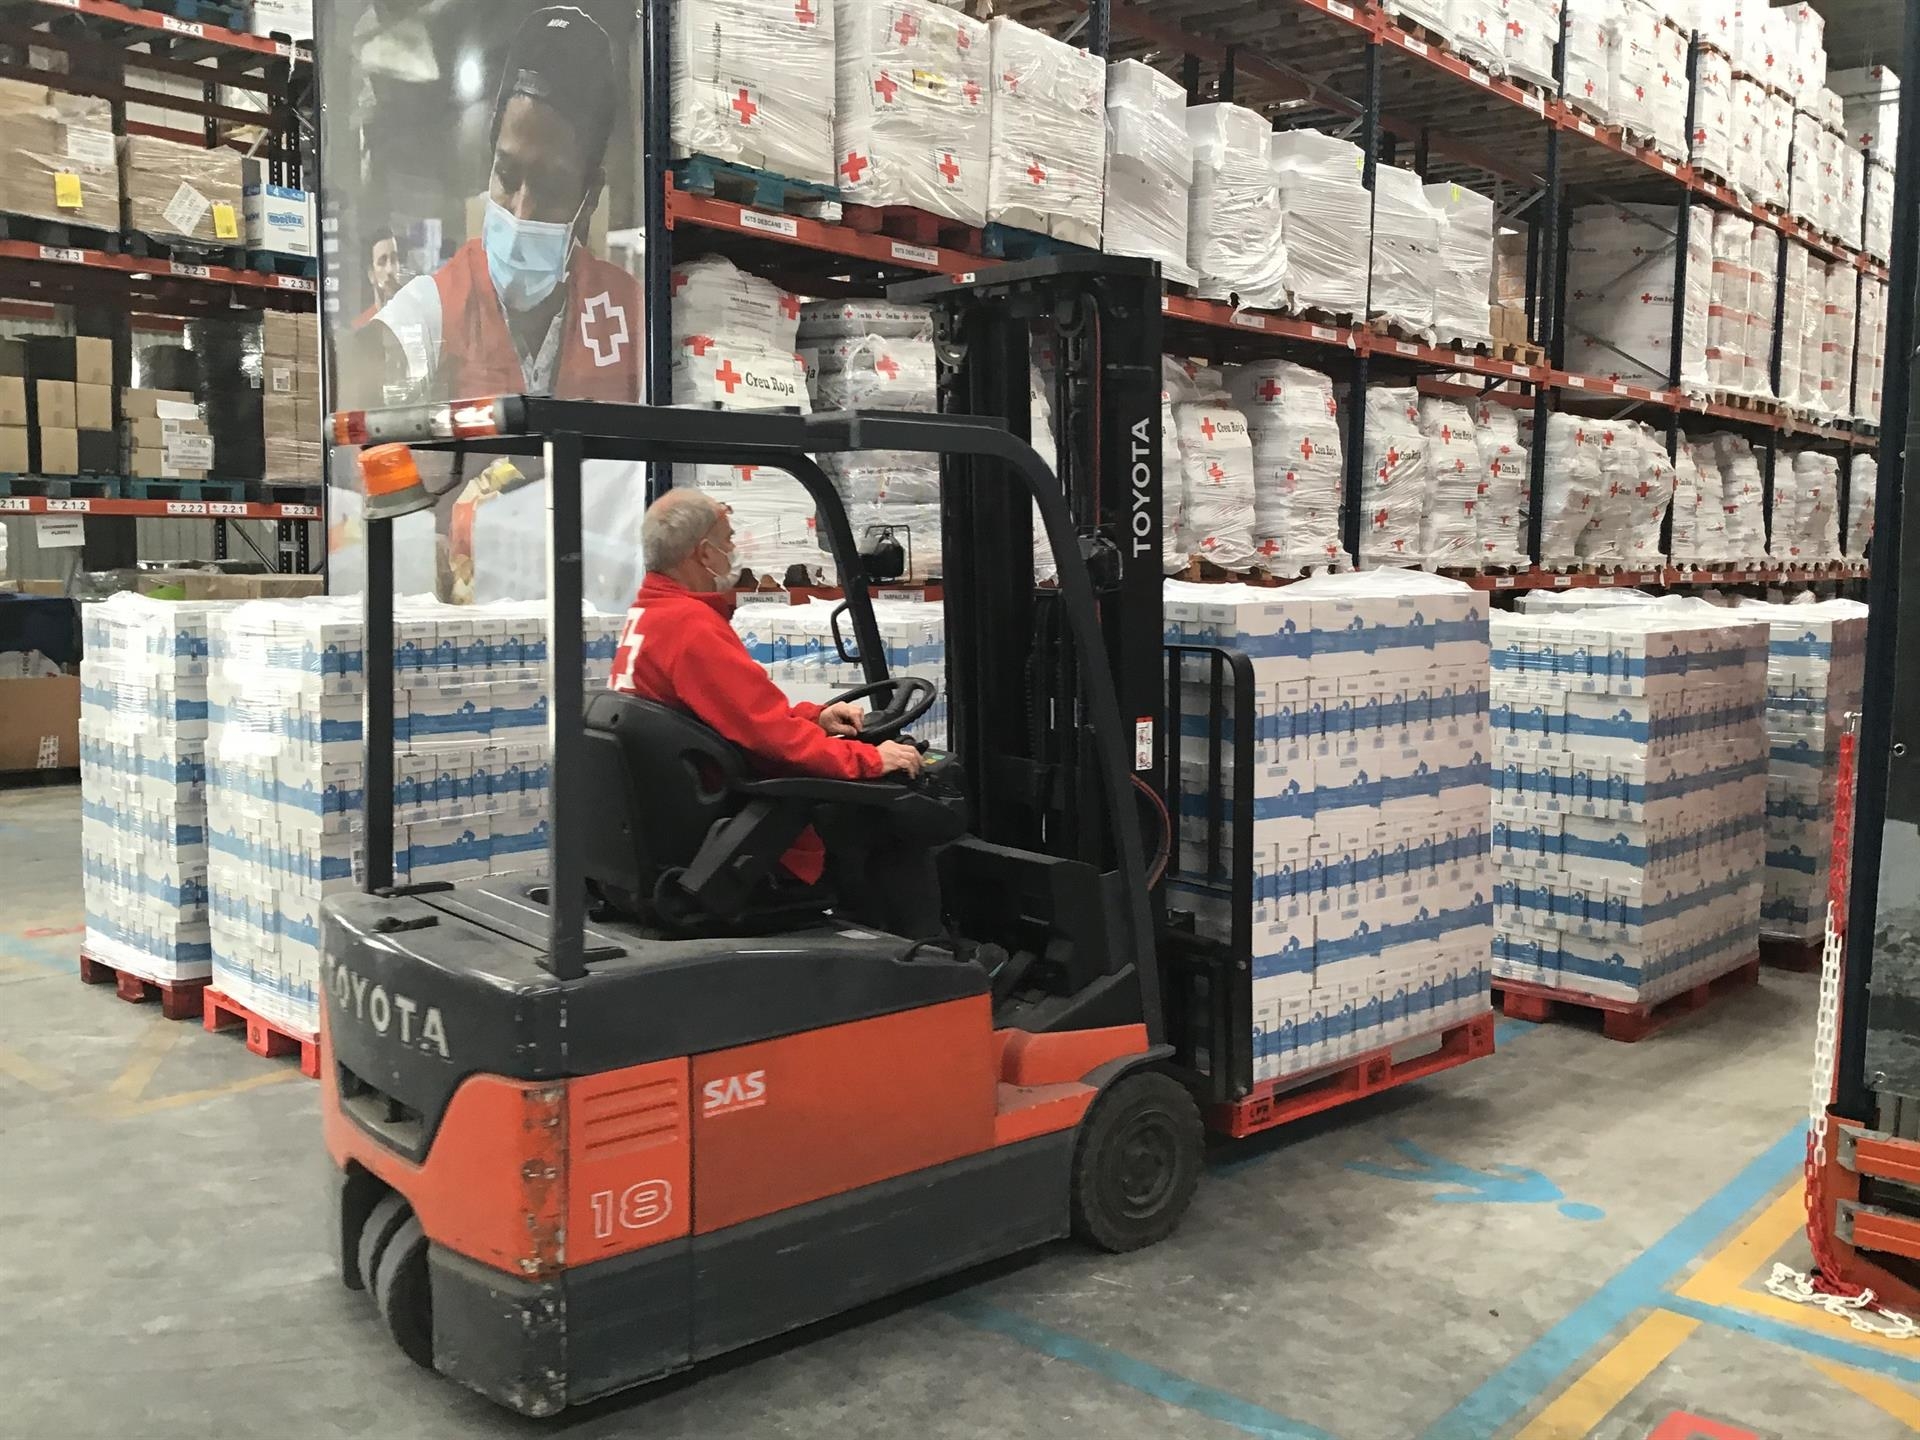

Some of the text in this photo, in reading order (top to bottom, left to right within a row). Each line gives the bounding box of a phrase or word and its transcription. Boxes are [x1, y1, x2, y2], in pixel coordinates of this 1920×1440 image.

[55, 249, 80, 260] 2.1.3
[184, 265, 207, 276] 2.2.3
[290, 279, 312, 289] 2.3.3
[745, 371, 795, 396] Creu Roja
[1217, 422, 1245, 435] Creu Roja
[1131, 417, 1151, 558] TOYOTA
[0, 500, 25, 508] 2.1.1
[62, 501, 86, 510] 2.1.2
[181, 504, 203, 513] 2.2.2
[222, 504, 243, 513] 2.2.1
[294, 505, 315, 515] 2.3.2
[703, 1070, 766, 1109] SAS
[591, 1179, 672, 1239] 18
